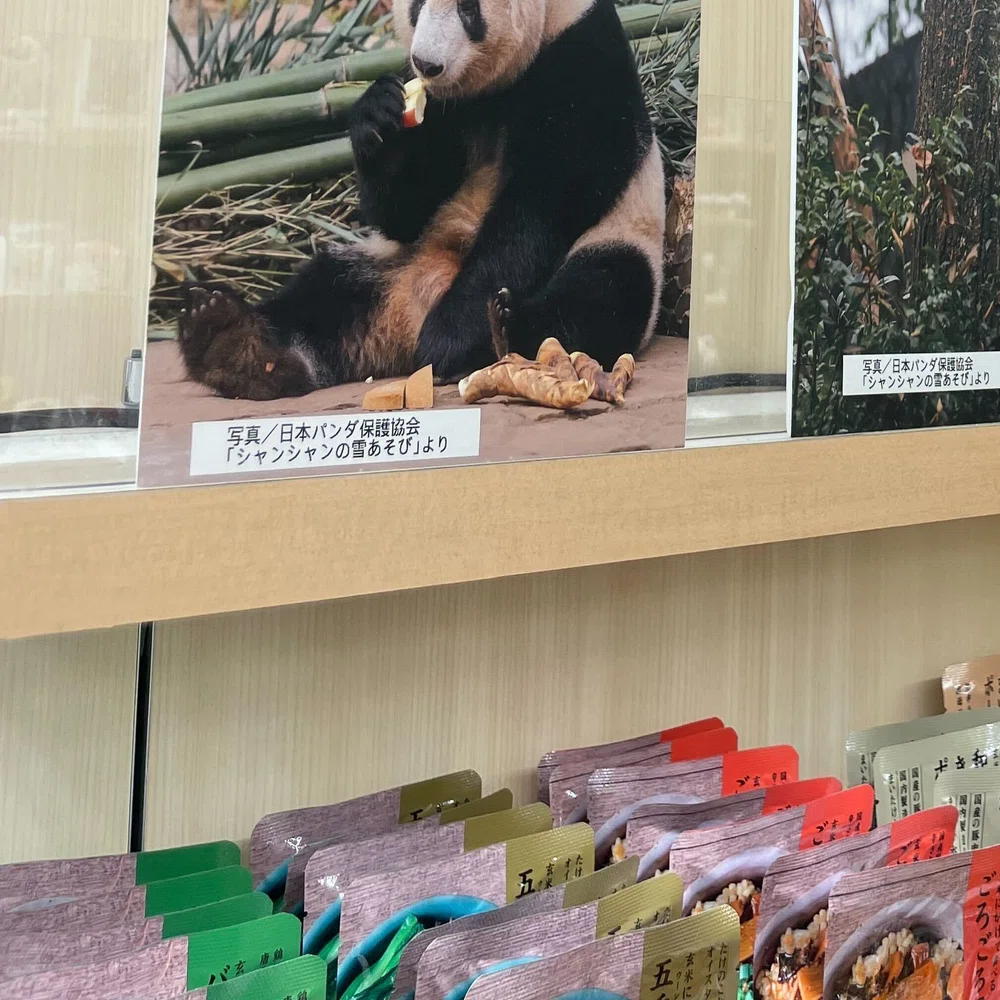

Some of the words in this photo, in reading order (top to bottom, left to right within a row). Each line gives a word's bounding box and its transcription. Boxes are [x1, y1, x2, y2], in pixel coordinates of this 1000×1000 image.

[862, 356, 974, 375] 写真／日本パンダ保護協会
[862, 371, 991, 390] 「シャンシャンの雪あそび」より
[225, 416, 421, 445] 写真／日本パンダ保護協会
[225, 434, 449, 466] 「シャンシャンの雪あそび」より
